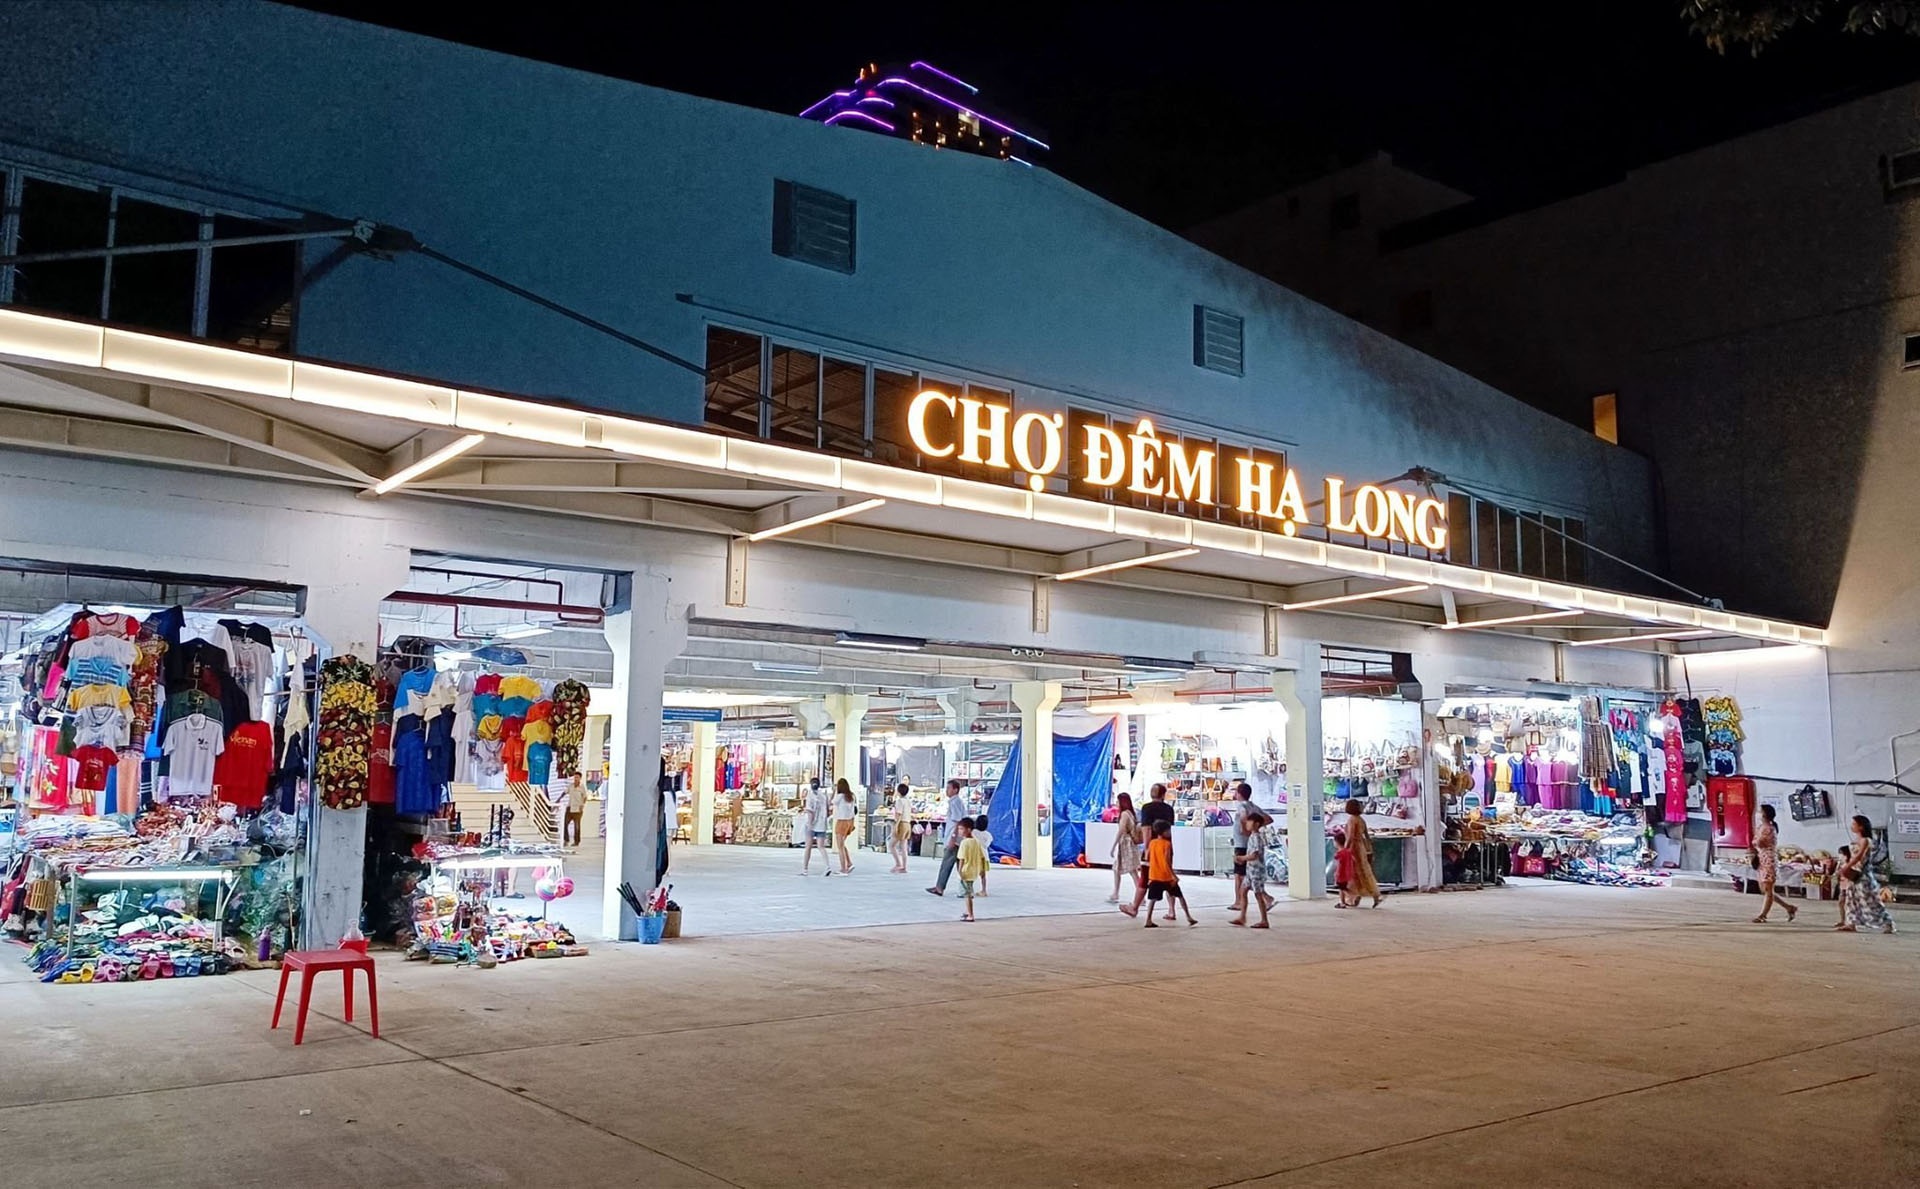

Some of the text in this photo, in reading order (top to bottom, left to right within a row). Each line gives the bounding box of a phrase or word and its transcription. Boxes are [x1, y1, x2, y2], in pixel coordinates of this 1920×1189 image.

[906, 389, 1450, 552] CHỢ ĐÊM HẠ LONG
